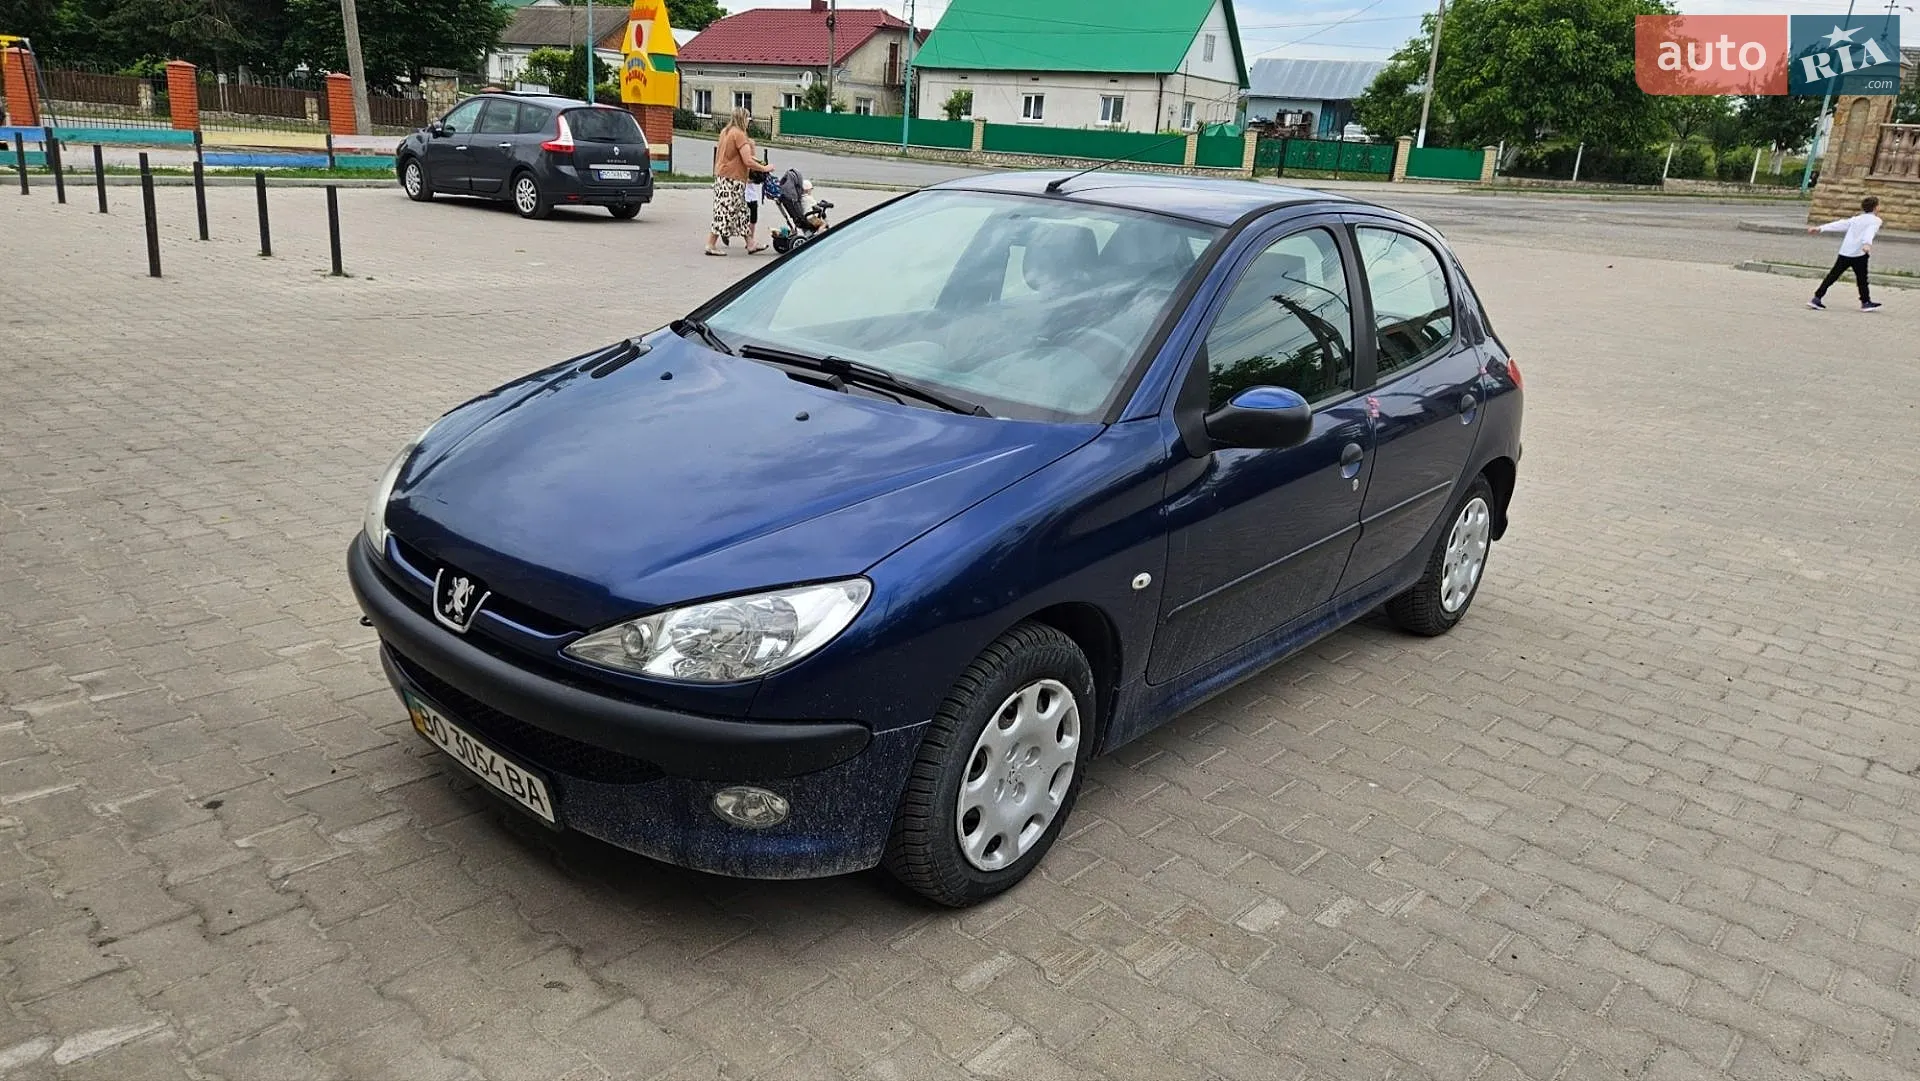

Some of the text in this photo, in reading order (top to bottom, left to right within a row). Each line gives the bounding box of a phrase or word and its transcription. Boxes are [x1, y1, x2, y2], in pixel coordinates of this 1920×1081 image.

[421, 706, 546, 812] BO 3054 BA
